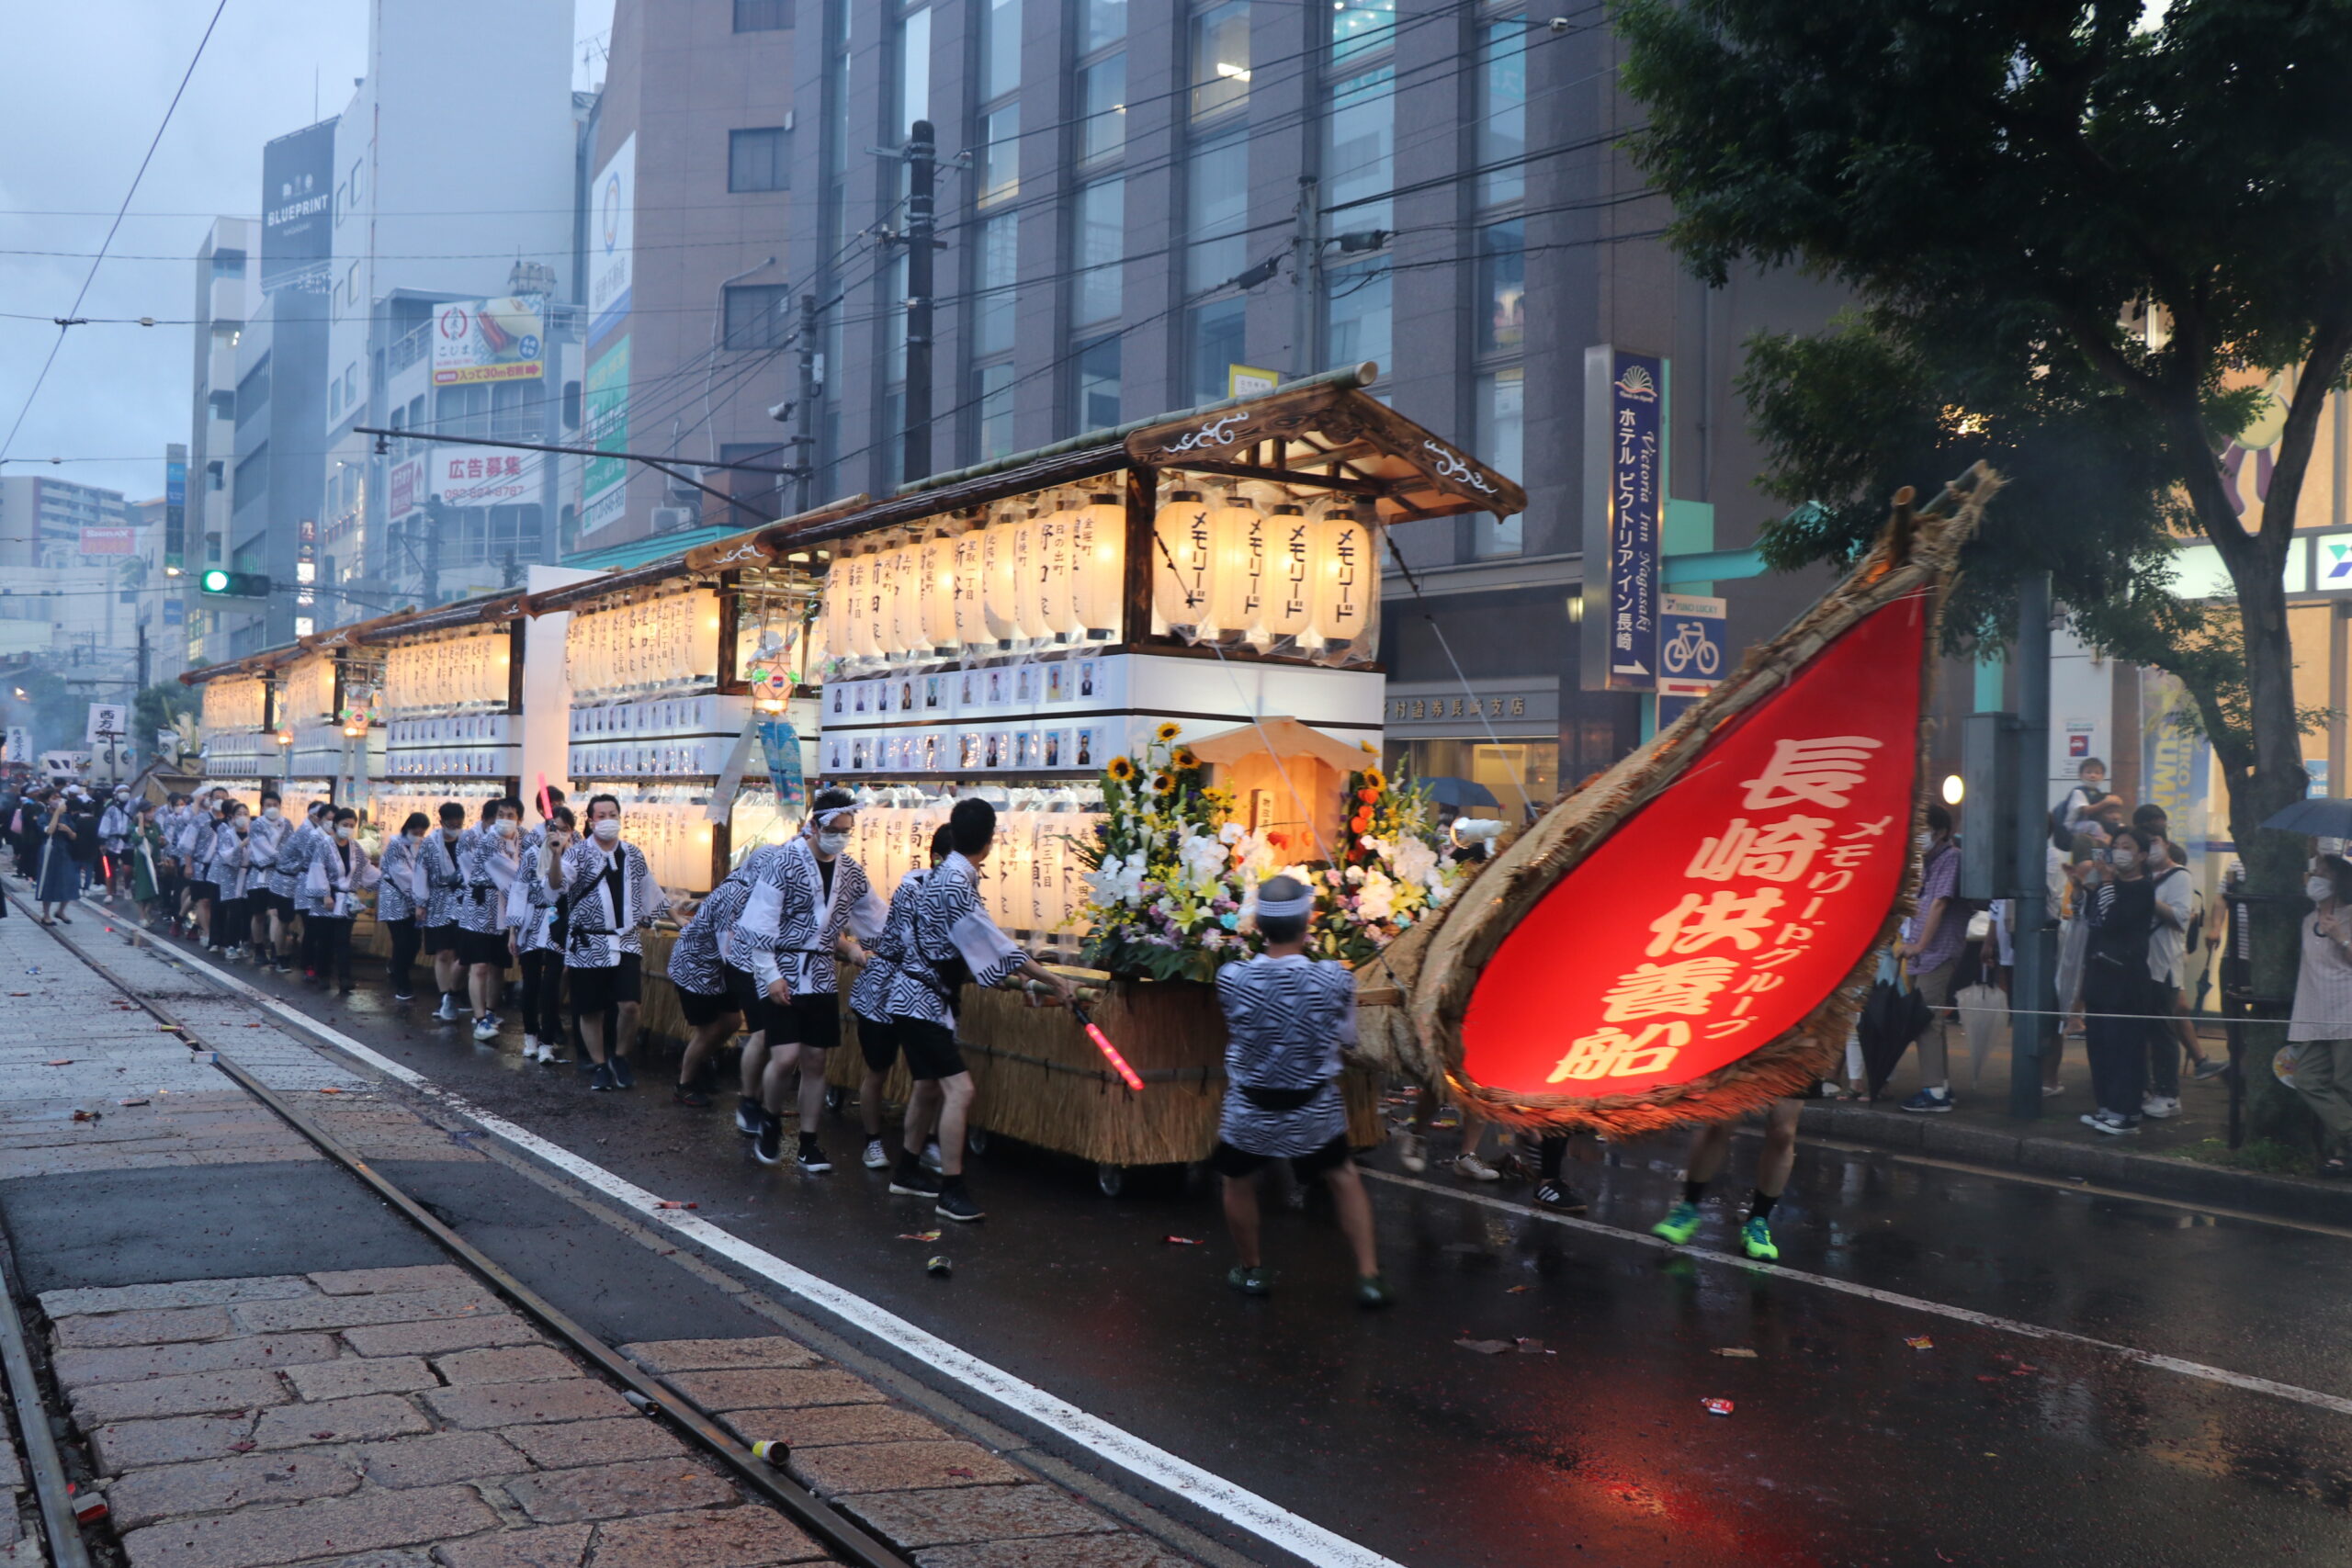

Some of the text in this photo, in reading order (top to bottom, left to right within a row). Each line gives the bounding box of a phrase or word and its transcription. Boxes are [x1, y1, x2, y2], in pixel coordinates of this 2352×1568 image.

[268, 194, 328, 226] BLUEPRINT
[439, 344, 469, 356] こじま
[449, 456, 521, 479] 広告募集
[1189, 512, 1207, 608] メモリード
[1245, 519, 1262, 615] メモリード
[1286, 525, 1305, 619] メモリード
[1337, 529, 1353, 623] メモリード
[1617, 408, 1636, 650] ホテル ビクトリア・イン長崎
[1635, 431, 1656, 632] Victoria Inn Nagasaki
[1546, 736, 1883, 1084] 長崎供養船
[1703, 815, 1894, 1041] メモリードグループ
